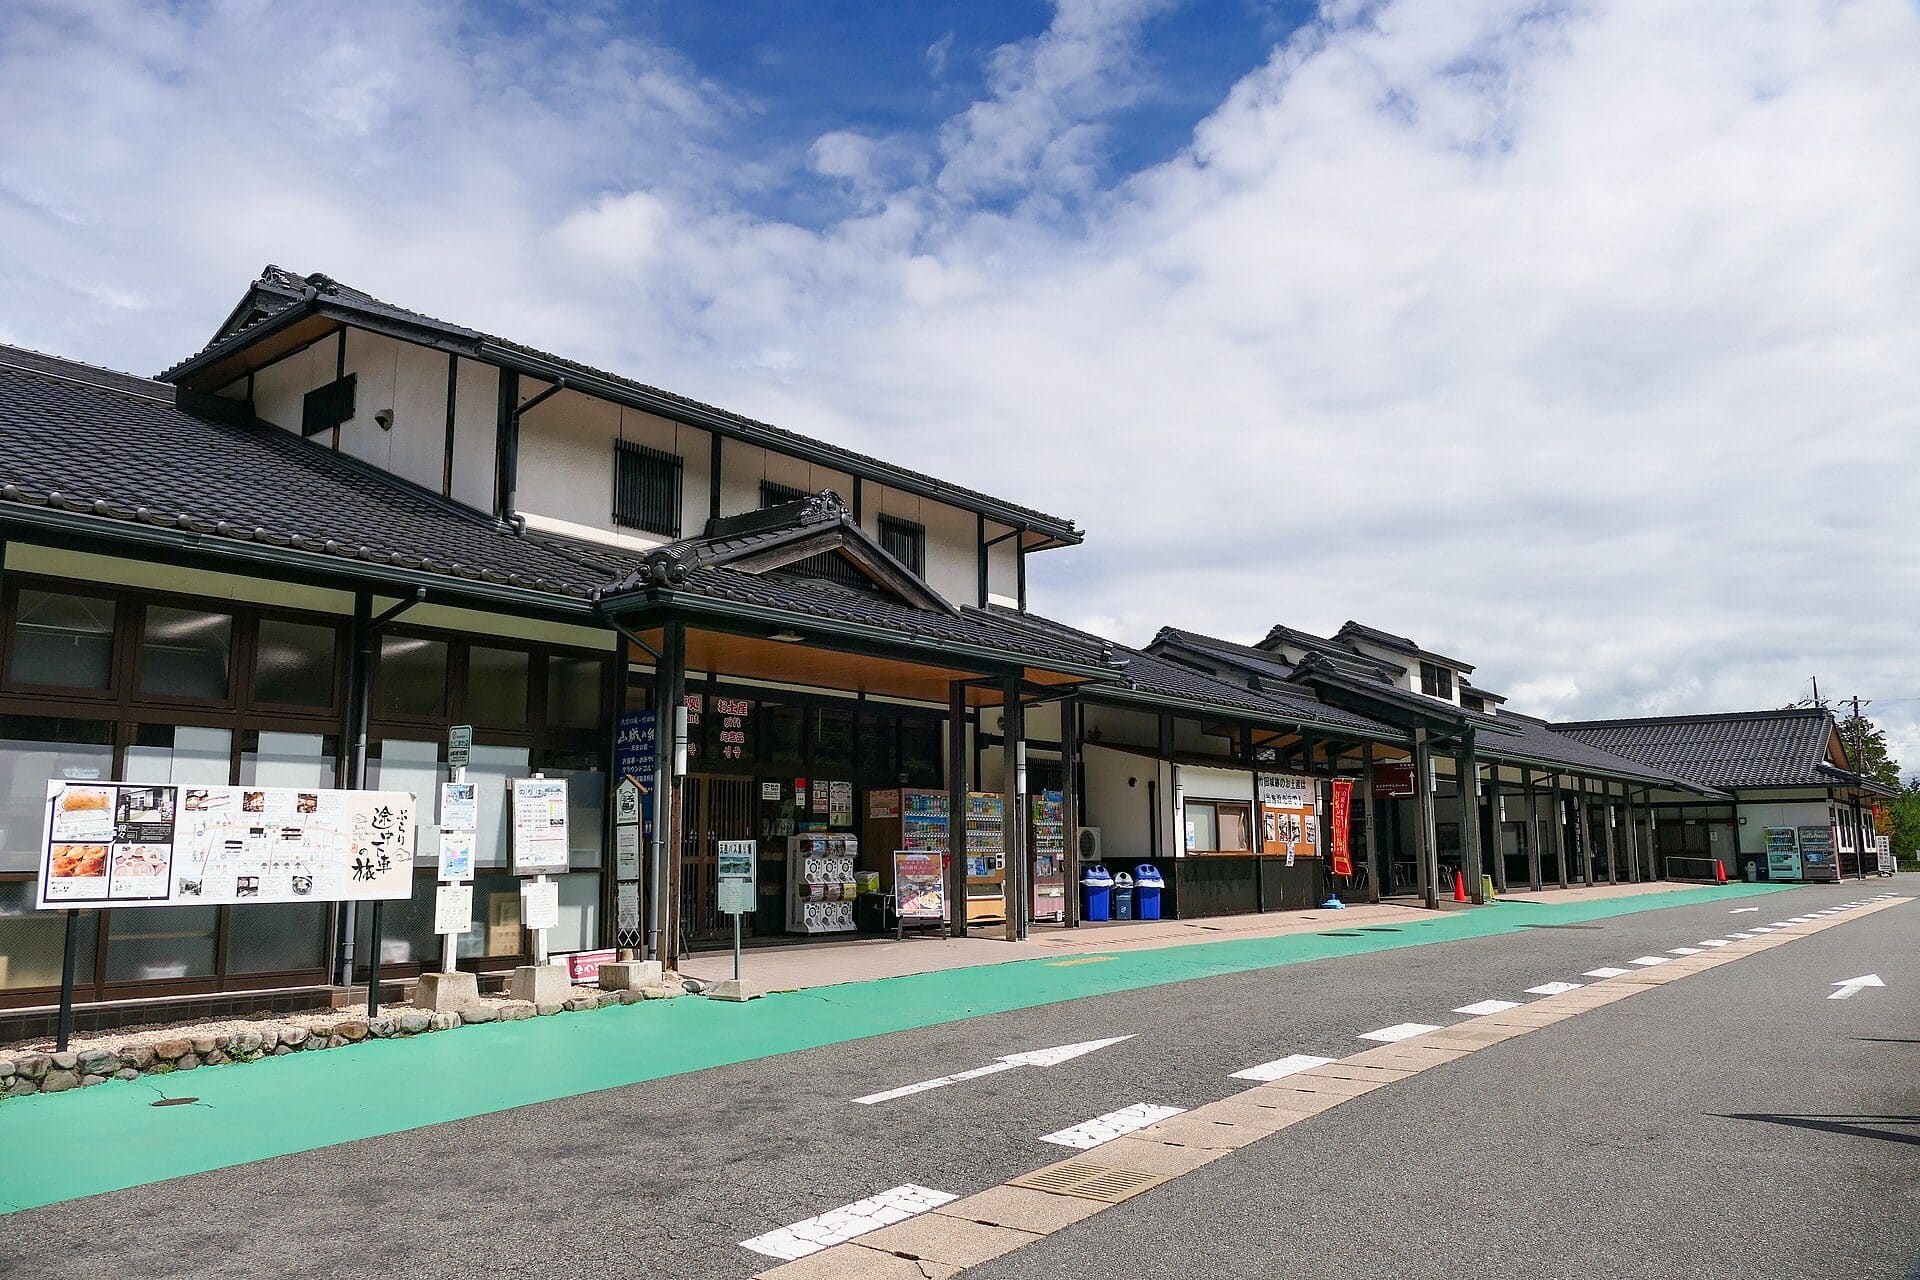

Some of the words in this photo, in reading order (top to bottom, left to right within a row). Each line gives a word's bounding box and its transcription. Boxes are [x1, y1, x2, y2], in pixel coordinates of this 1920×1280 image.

[717, 699, 748, 716] お土産
[724, 717, 742, 728] Gift
[622, 765, 654, 774] グラウンドゴル
[371, 805, 395, 875] 途中下車
[396, 809, 408, 845] ぶらり
[351, 847, 377, 882] の旅
